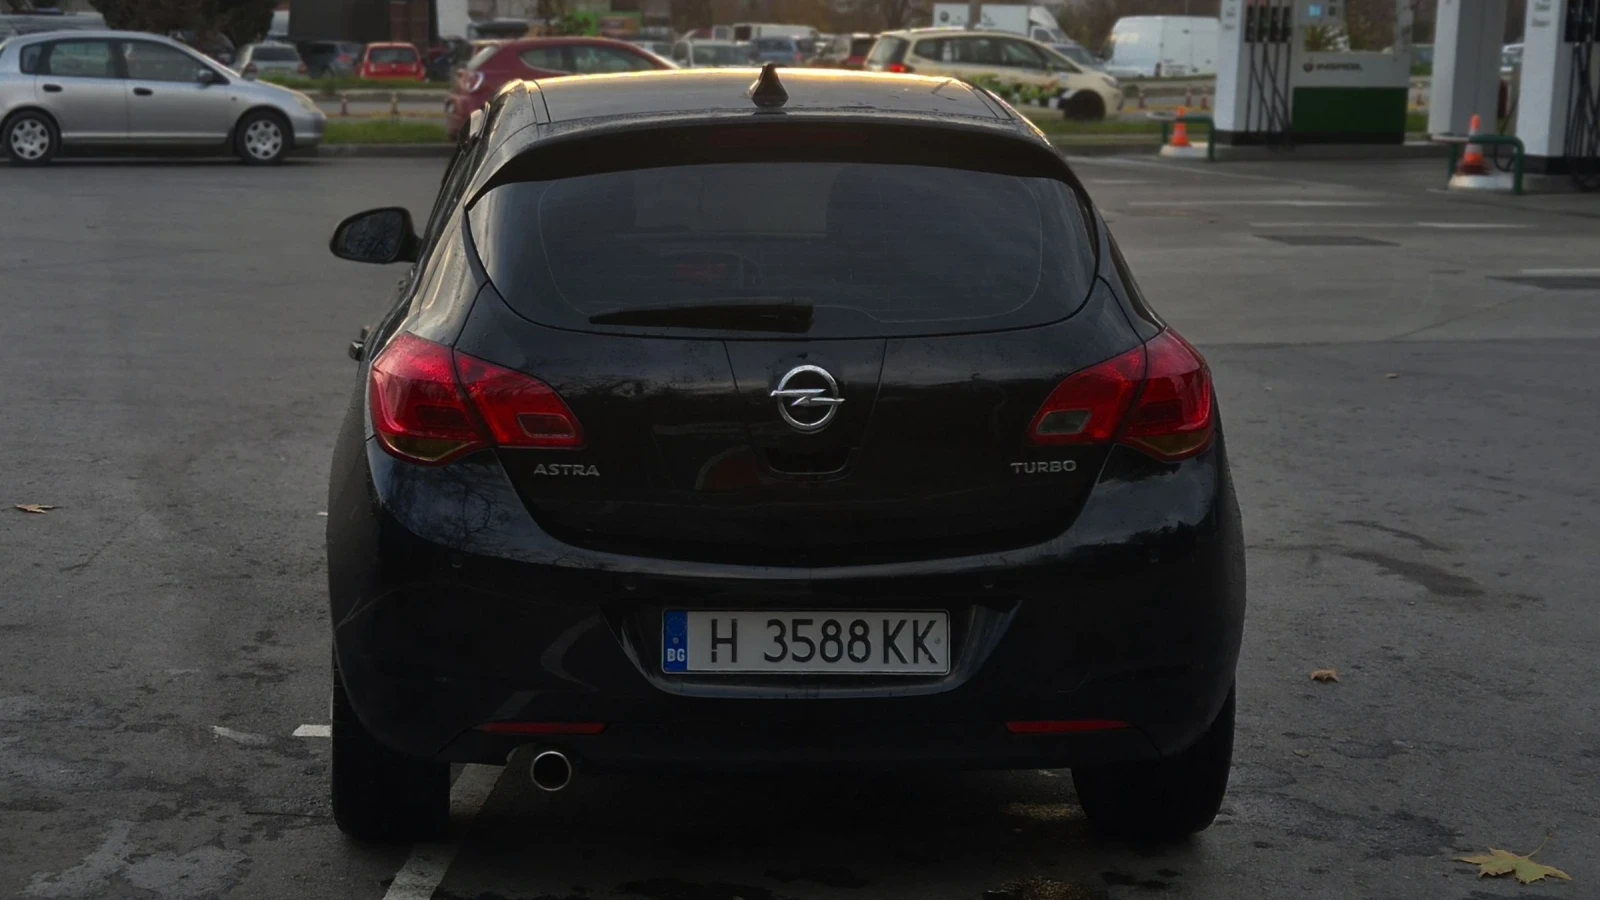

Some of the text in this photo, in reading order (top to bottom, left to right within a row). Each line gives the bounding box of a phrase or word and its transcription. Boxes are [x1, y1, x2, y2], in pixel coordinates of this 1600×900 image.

[533, 463, 600, 476] ASTRA
[1010, 460, 1077, 474] TURBO
[667, 648, 686, 662] BG
